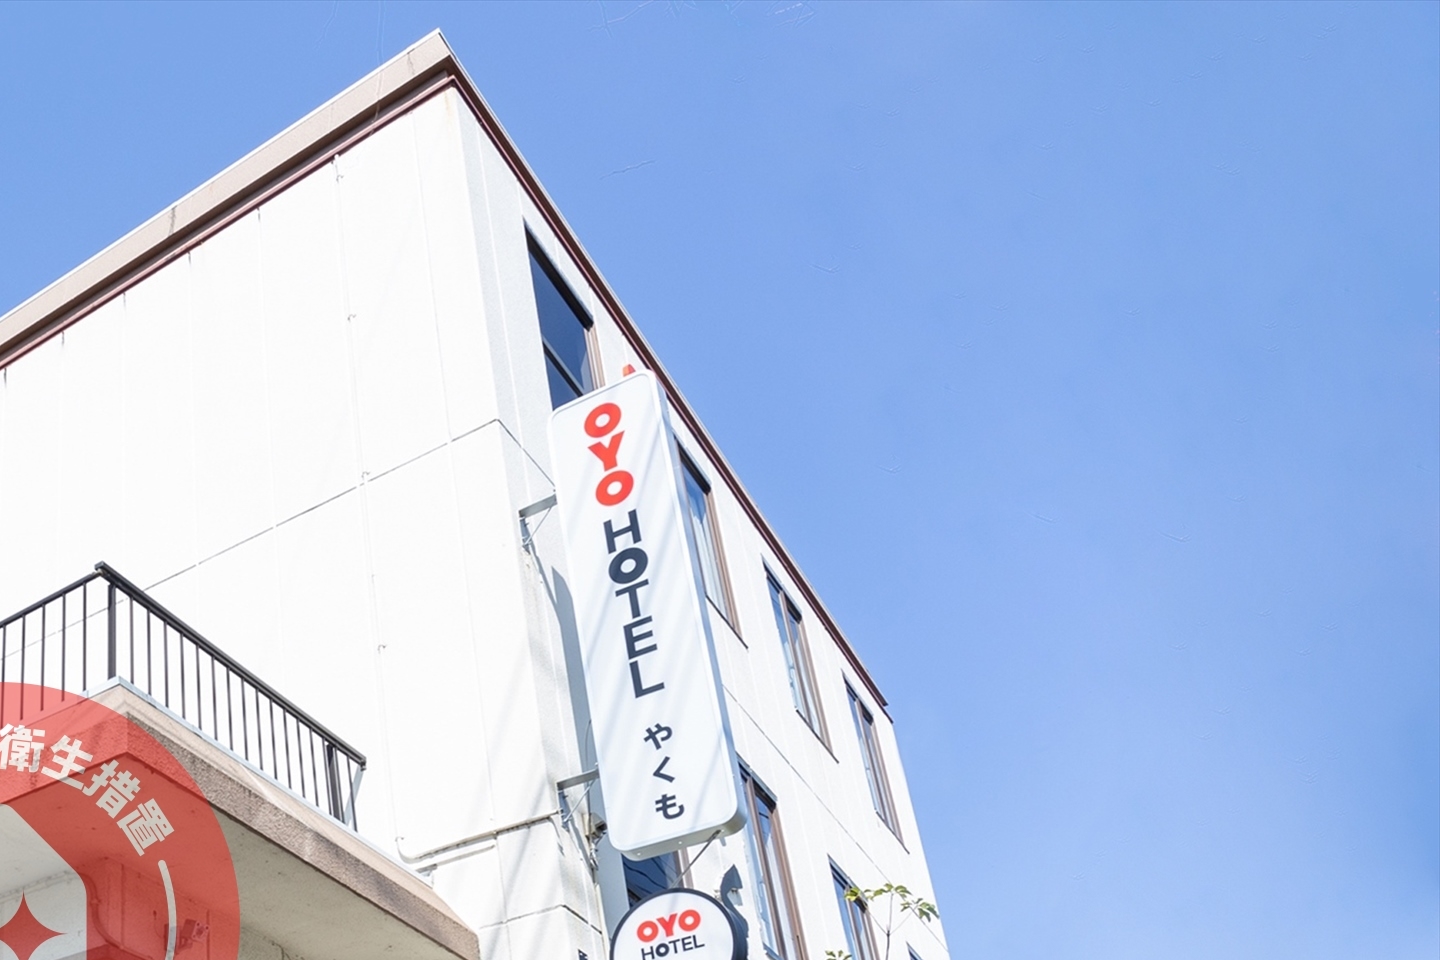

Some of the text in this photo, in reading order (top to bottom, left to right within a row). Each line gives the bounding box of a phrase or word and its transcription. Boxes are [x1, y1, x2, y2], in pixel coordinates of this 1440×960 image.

[584, 402, 685, 820] OYO HOTEL やくも
[636, 908, 701, 943] OYO
